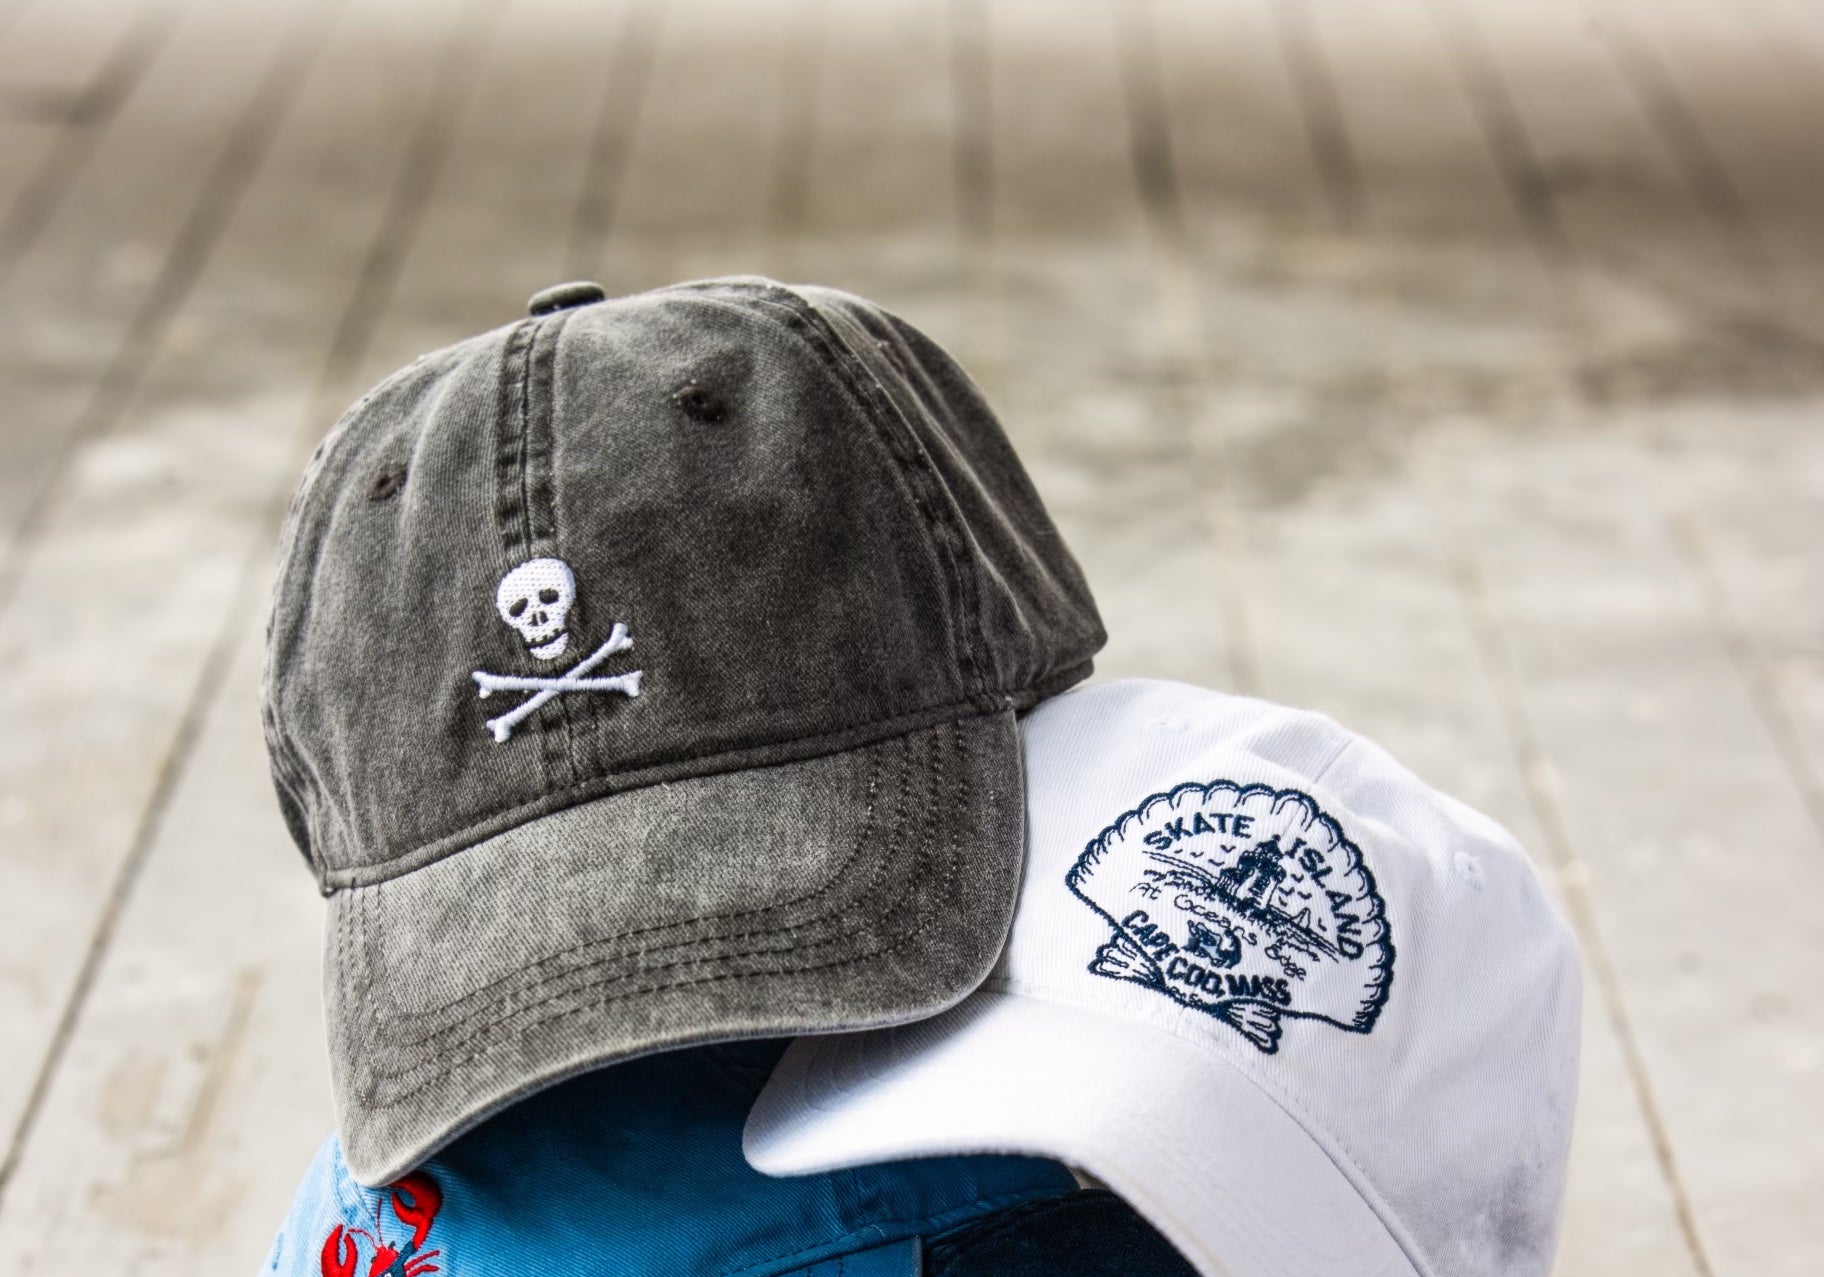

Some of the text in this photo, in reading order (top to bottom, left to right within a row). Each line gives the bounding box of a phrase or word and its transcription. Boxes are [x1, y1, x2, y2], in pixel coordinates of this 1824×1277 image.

[1129, 882, 1162, 900] At
[1143, 812, 1364, 960] SKATE ISLAND
